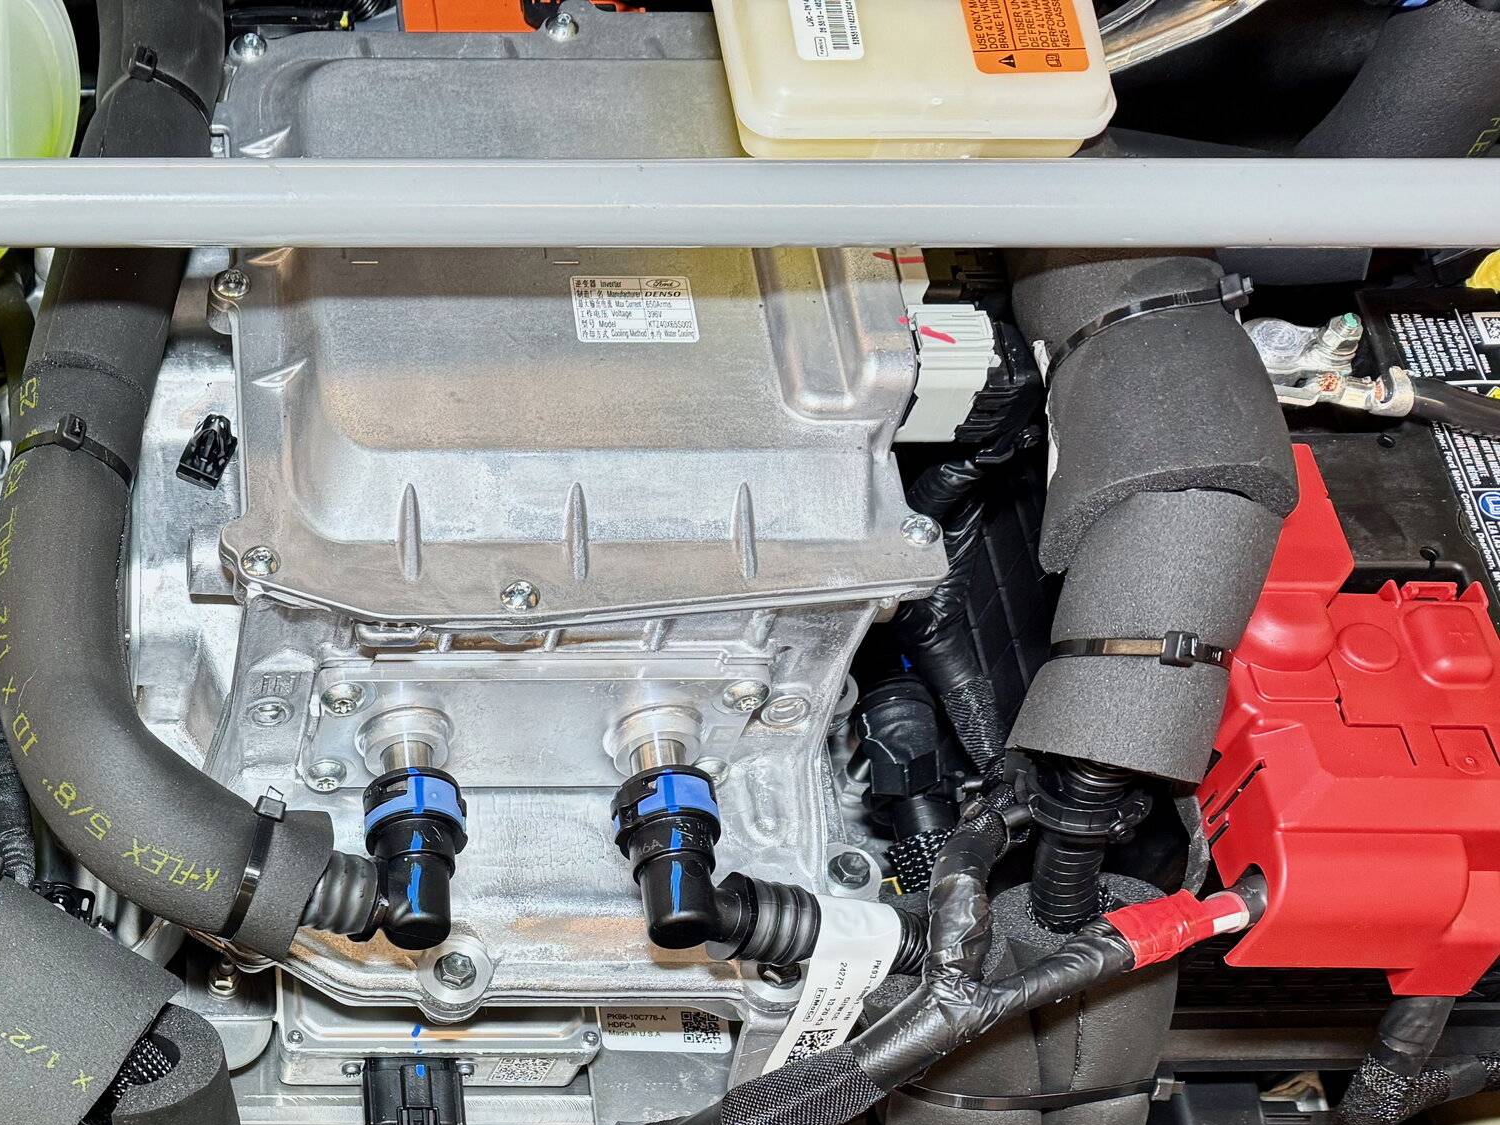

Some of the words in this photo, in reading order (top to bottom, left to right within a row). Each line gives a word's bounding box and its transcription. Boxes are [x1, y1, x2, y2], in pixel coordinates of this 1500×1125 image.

[972, 10, 984, 31] ONLY
[982, 14, 992, 24] LV
[1012, 12, 1030, 48] UTILISER
[1024, 10, 1038, 37] FREIN
[1036, 12, 1045, 23] LV
[977, 33, 987, 49] USE
[986, 33, 999, 49] DOT
[995, 22, 1009, 48] BRAKE
[1027, 38, 1040, 48] DE
[1040, 30, 1050, 48] DOT
[598, 320, 617, 328] Model
[1447, 319, 1476, 370] NON-SPILLABLE
[1444, 451, 1458, 469] Ford
[1451, 469, 1466, 491] Motor
[2, 674, 18, 705] X
[12, 711, 40, 757] ID
[121, 838, 221, 894] K-FLEX
[70, 1069, 95, 1095] X
